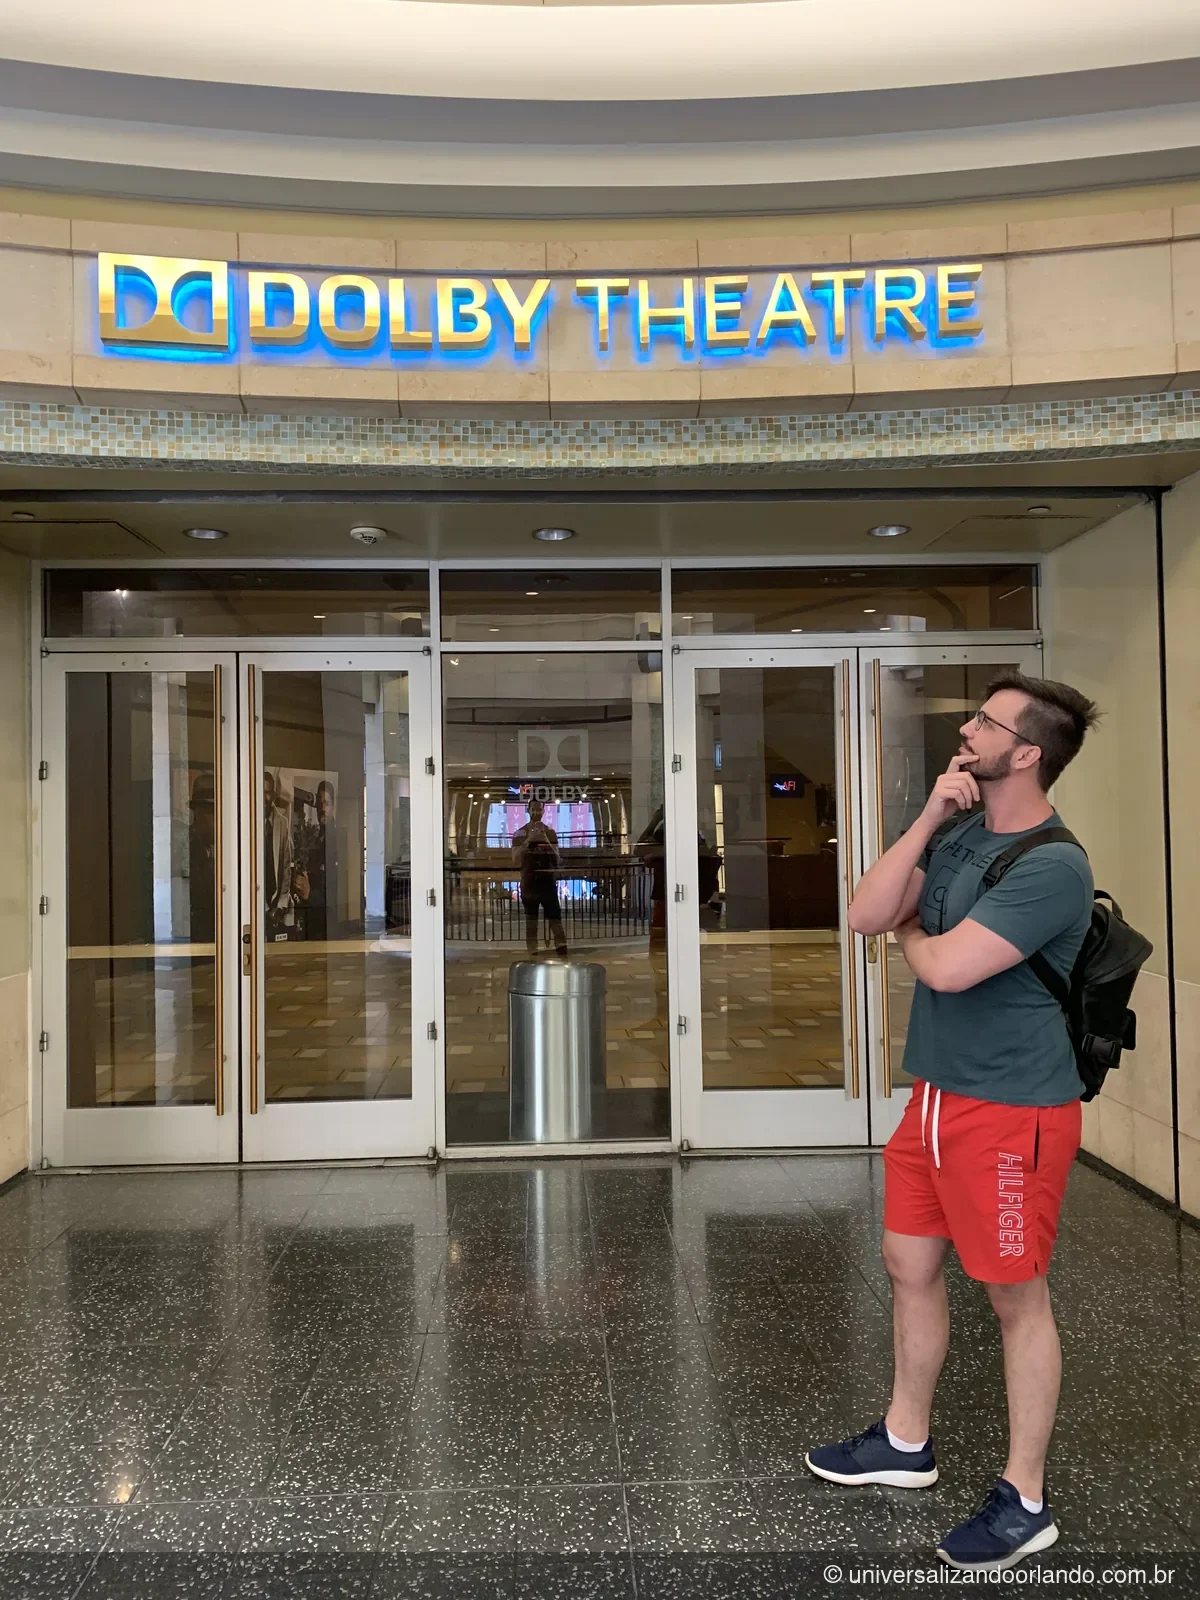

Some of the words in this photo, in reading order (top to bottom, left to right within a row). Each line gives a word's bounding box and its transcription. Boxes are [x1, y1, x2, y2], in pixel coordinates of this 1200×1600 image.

[248, 271, 551, 352] DOLBY
[575, 263, 985, 352] THEATRE
[519, 785, 591, 802] DOLBY
[997, 1152, 1025, 1257] HILFIGER
